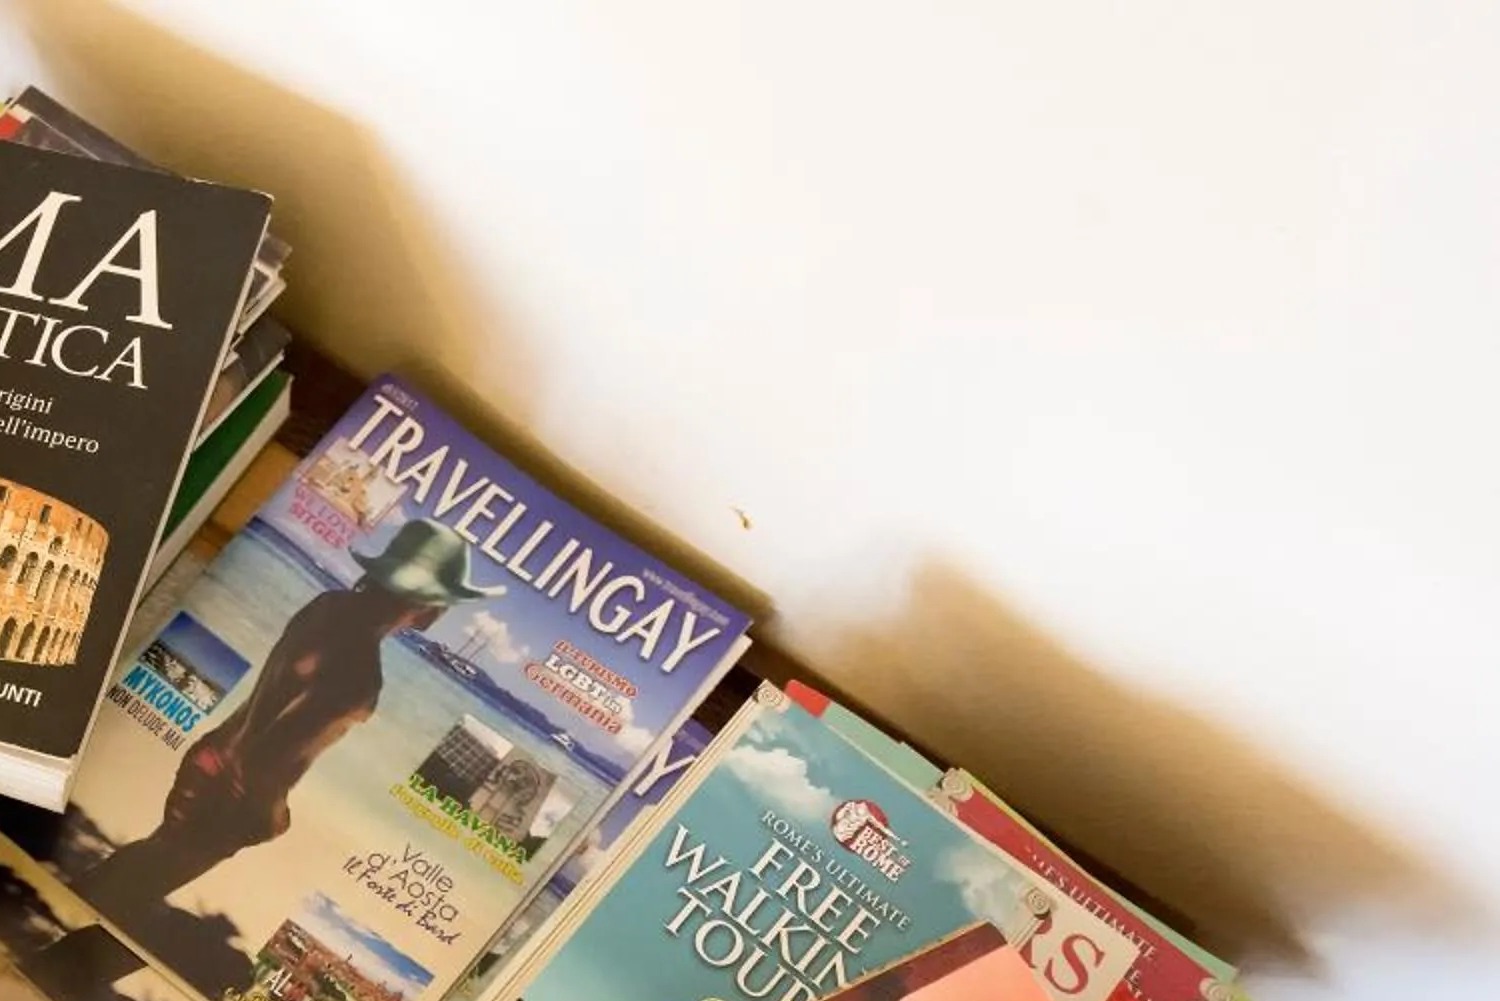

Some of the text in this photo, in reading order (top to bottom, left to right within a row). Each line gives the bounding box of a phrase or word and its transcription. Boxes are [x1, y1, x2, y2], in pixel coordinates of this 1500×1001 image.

[348, 393, 721, 673] TRAVELLINGAY
[106, 685, 129, 713] NON
[121, 664, 202, 733] MYKONOS
[522, 661, 624, 736] Germania
[403, 841, 455, 893] Valle
[761, 809, 911, 932] ROME'S ULTIMATE
[852, 838, 906, 882] ROME
[861, 823, 898, 855] BEST
[749, 837, 881, 955] FREE
